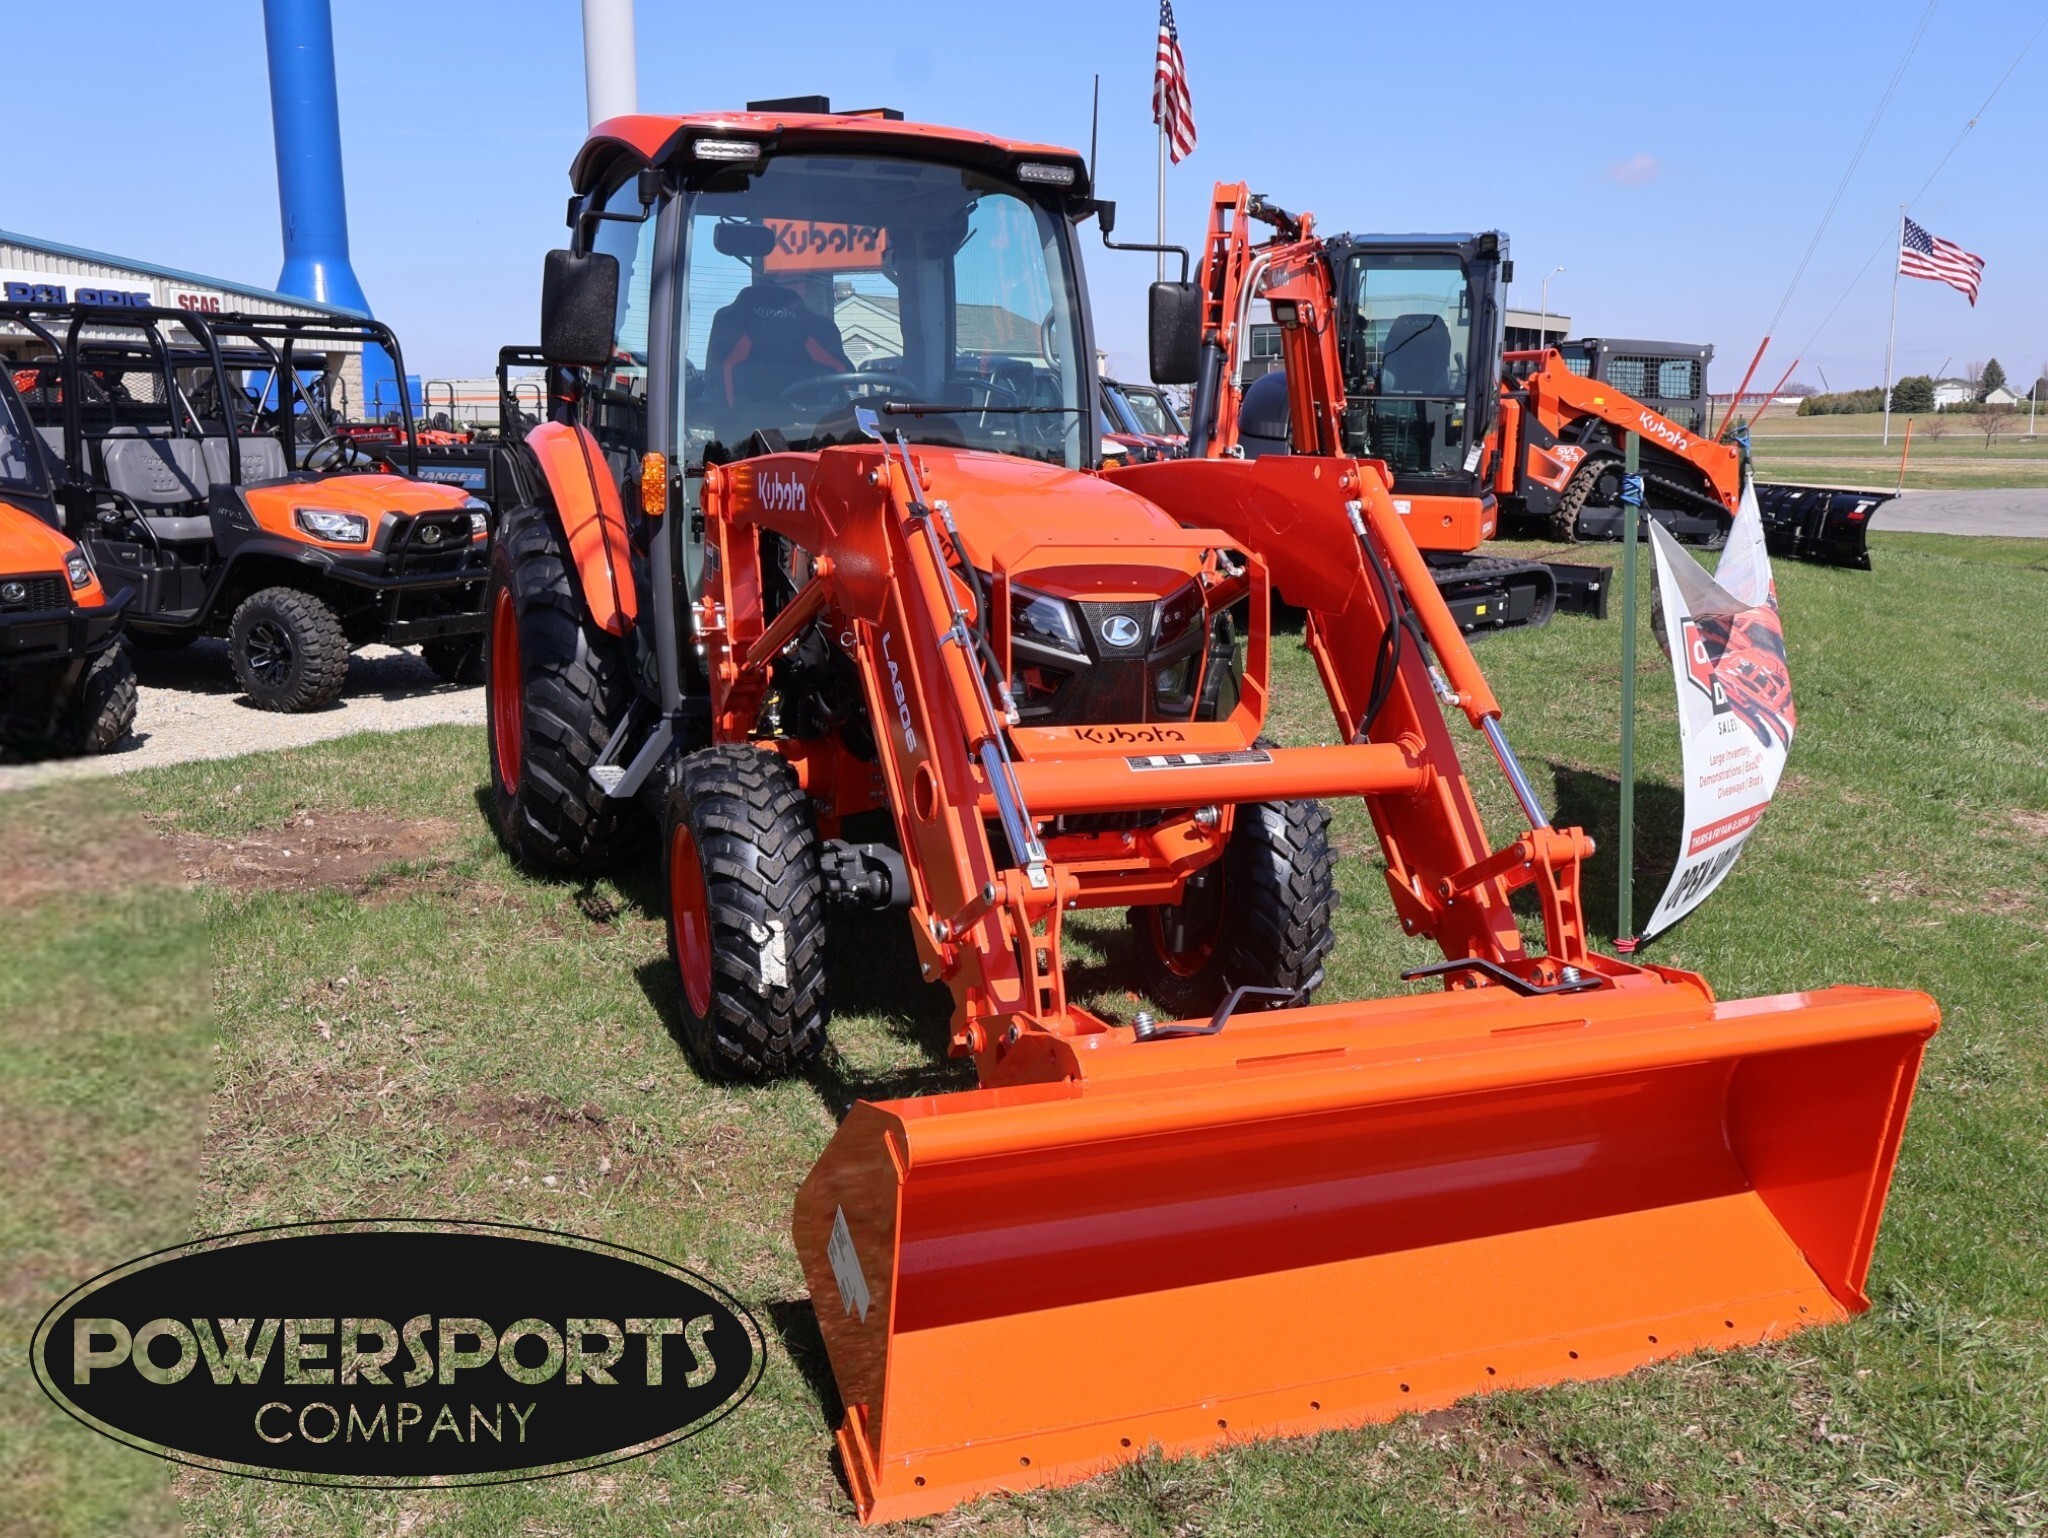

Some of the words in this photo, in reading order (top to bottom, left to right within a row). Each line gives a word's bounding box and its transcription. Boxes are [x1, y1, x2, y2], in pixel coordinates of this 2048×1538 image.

[771, 222, 878, 255] Kubota
[178, 294, 220, 313] SCAG
[1639, 411, 1688, 451] Kubota
[1556, 447, 1578, 456] SVL
[417, 471, 482, 481] RANGER
[758, 471, 806, 512] Kubota
[882, 631, 917, 753] LA806
[1074, 726, 1185, 744] Kubota
